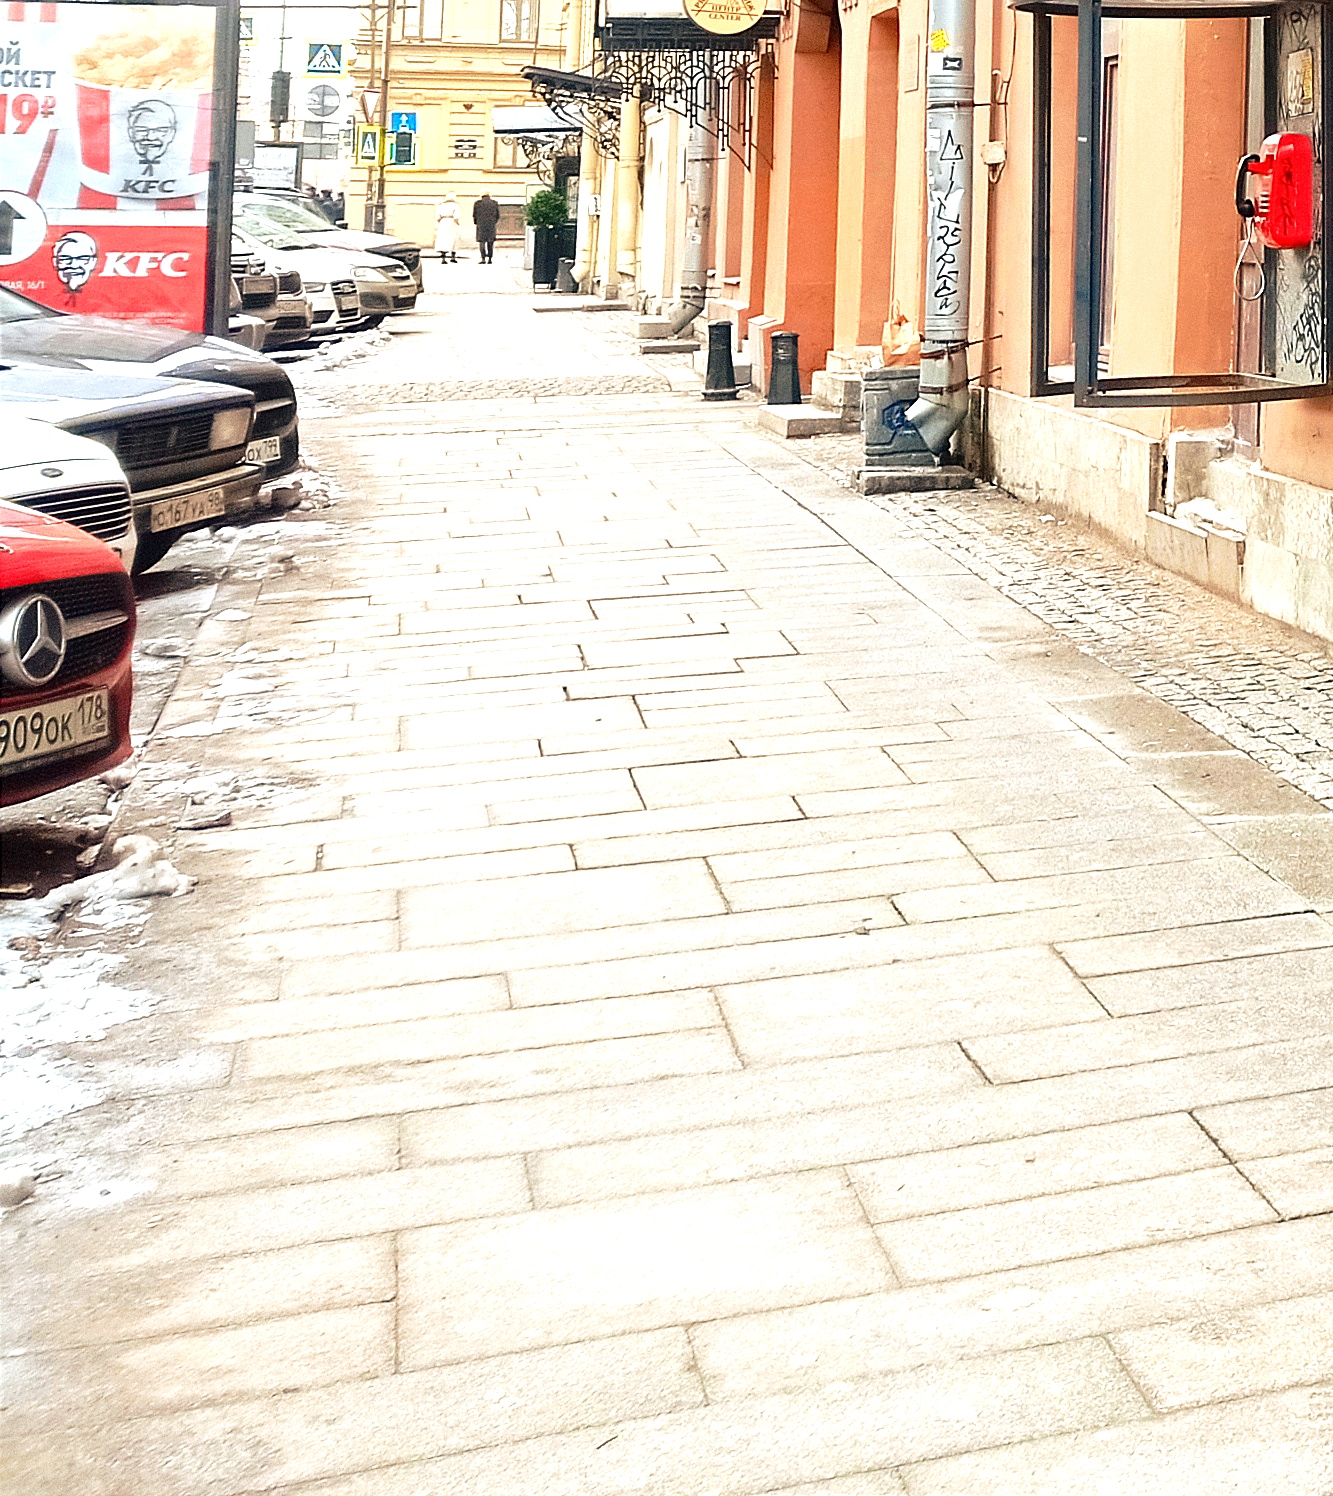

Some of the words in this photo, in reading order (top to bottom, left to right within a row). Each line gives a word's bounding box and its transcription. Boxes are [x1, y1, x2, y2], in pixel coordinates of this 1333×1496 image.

[708, 13, 741, 21] CENTER
[119, 178, 176, 194] KFC
[98, 252, 190, 278] KFC
[77, 693, 104, 725] 178
